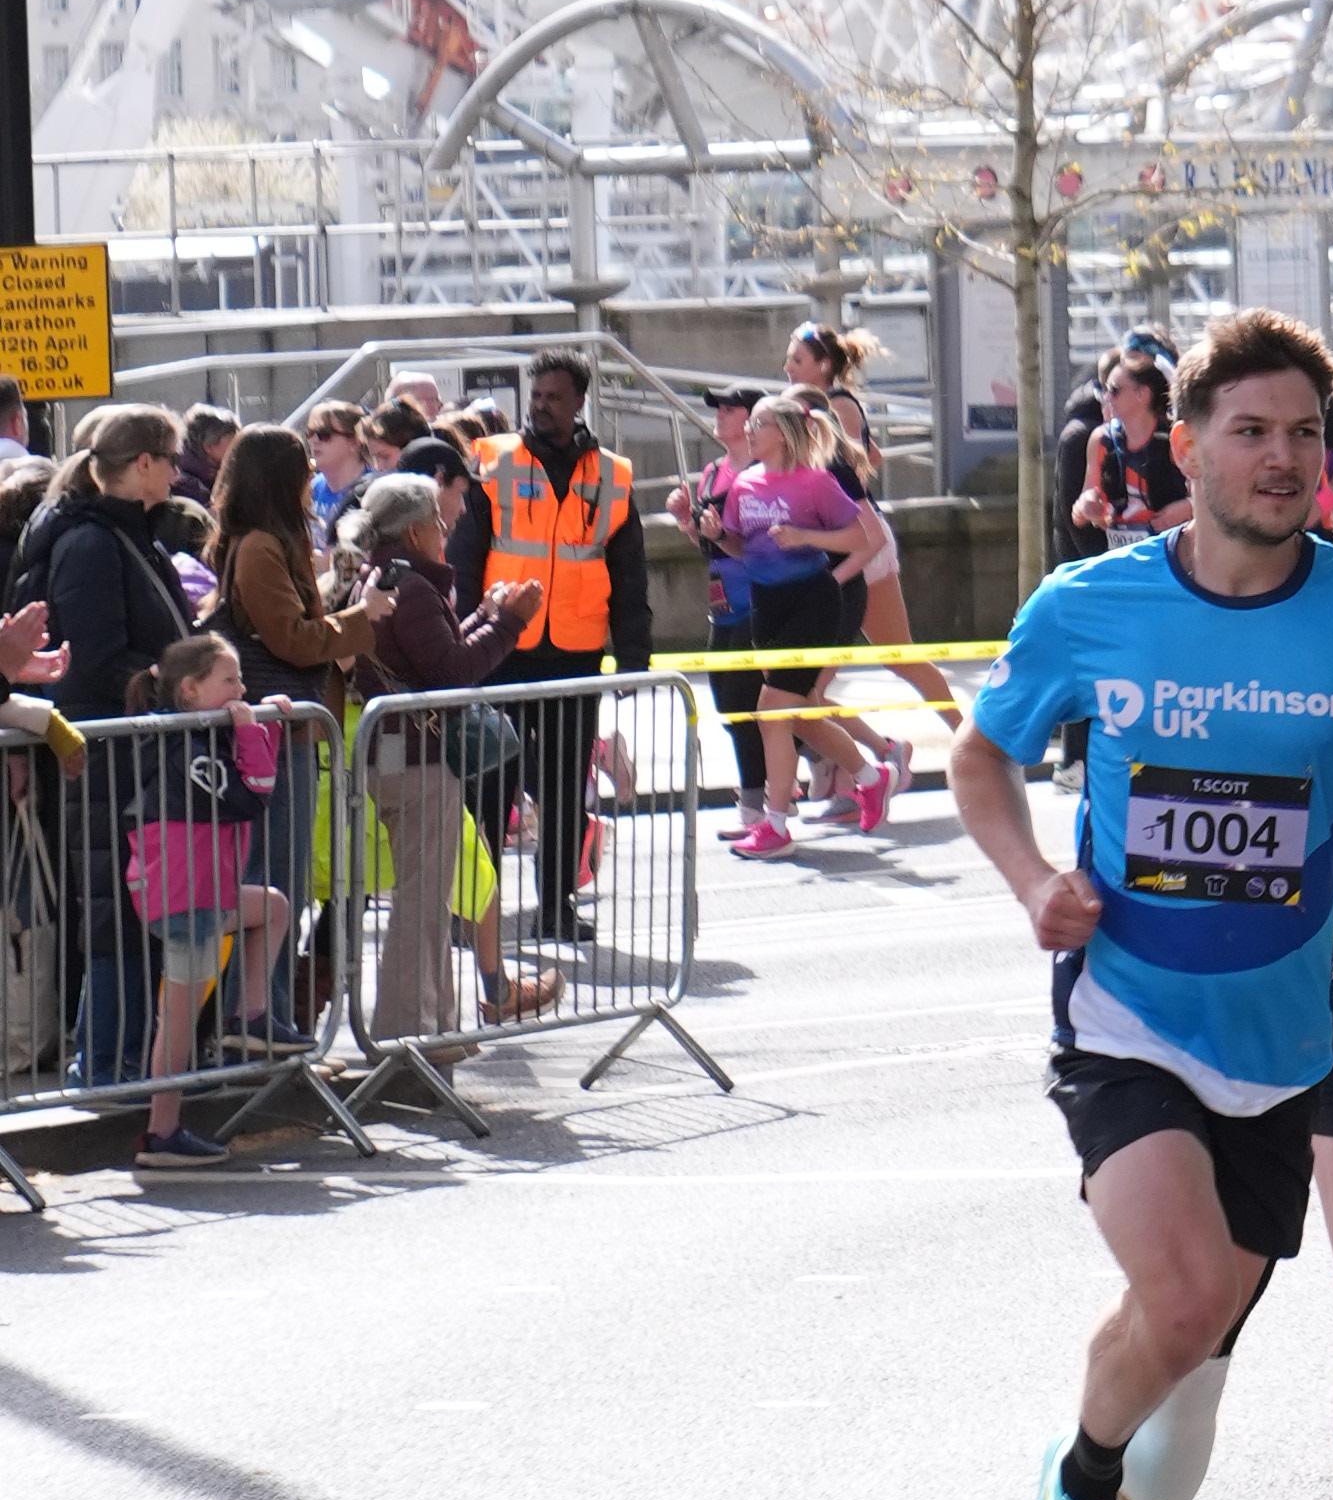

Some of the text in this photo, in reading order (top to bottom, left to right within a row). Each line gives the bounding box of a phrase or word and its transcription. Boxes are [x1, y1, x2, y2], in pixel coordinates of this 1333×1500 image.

[11, 252, 88, 272] Warning
[3, 274, 66, 291] Closed
[0, 293, 95, 311] andmarks
[1, 334, 88, 355] 12th April
[20, 354, 69, 372] 16:30
[1152, 708, 1210, 740] UK
[1192, 777, 1250, 795] T.SCOTT
[1155, 808, 1280, 859] 1004
